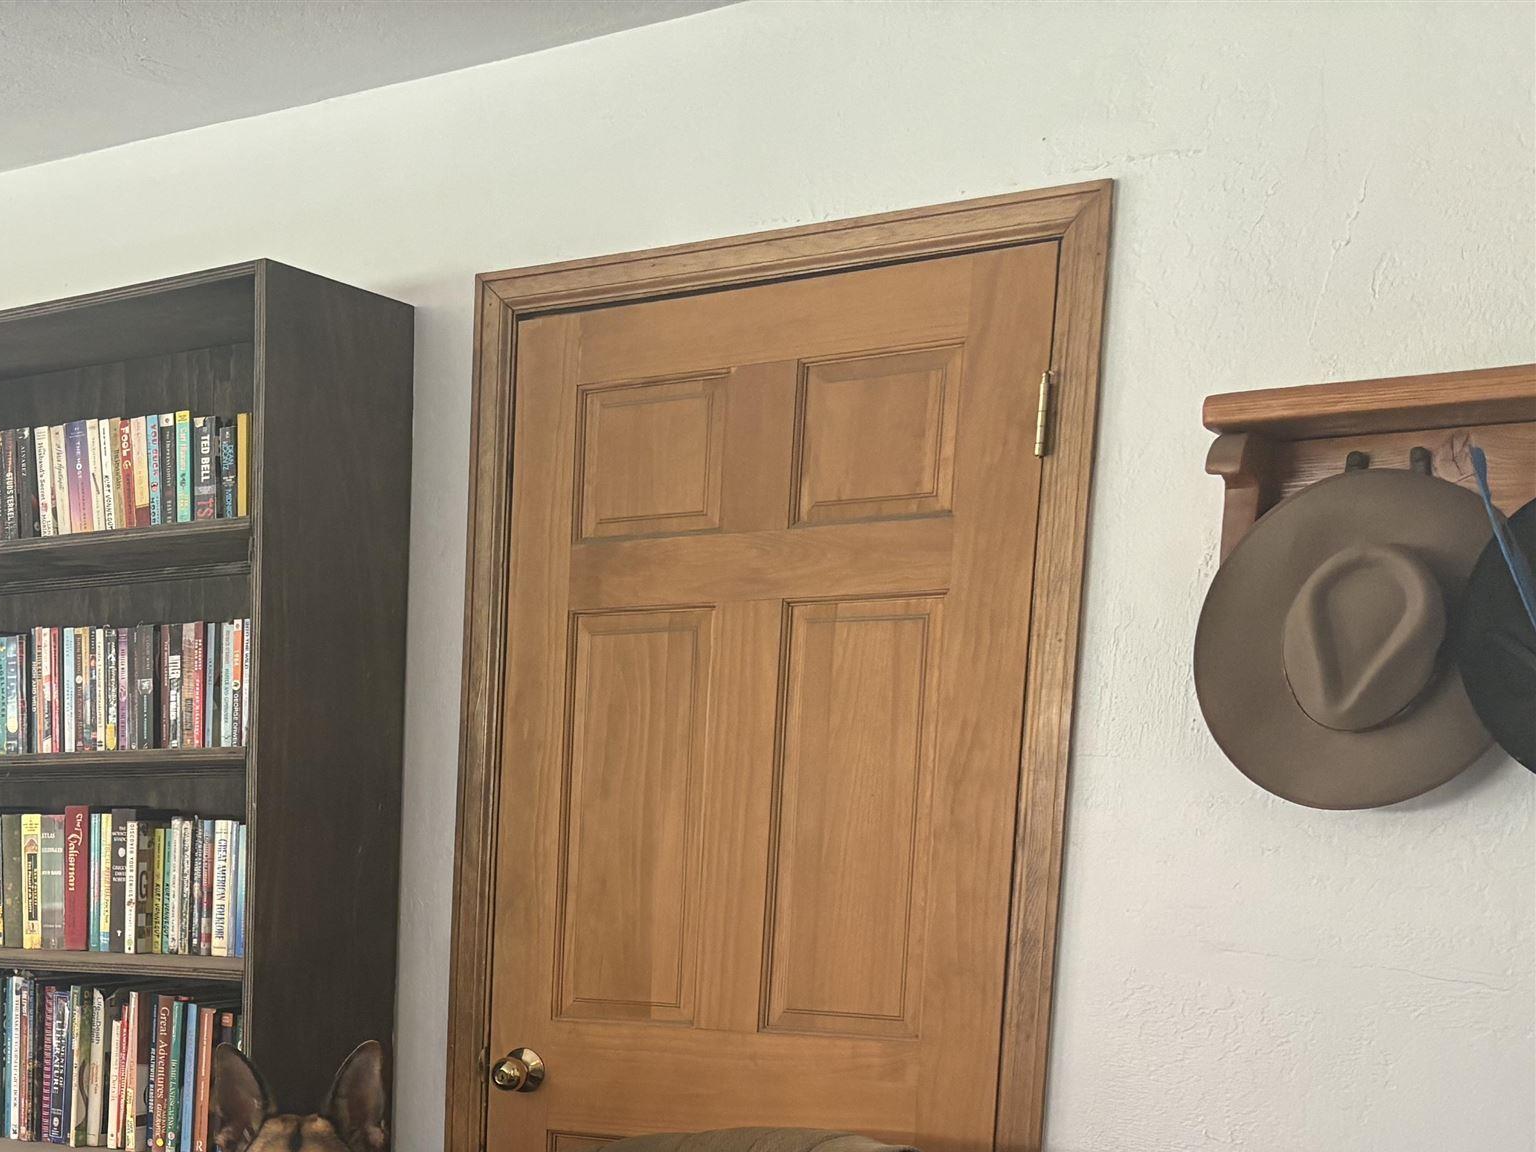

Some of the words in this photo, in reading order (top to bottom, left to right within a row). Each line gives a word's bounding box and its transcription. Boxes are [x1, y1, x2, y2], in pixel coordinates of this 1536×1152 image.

[200, 434, 210, 454] TED
[37, 442, 46, 479] Husband's
[201, 457, 210, 483] BELL
[6, 472, 14, 495] STUDS
[6, 495, 15, 522] TERKEL
[105, 494, 113, 529] VONNEGUT
[168, 655, 181, 680] HITLER
[67, 830, 82, 892] Talisman
[217, 839, 228, 863] GREAT
[216, 864, 227, 901] AMERICAN
[215, 904, 226, 940] FOLKLORE
[159, 1006, 170, 1036] Great
[156, 1040, 169, 1099] Adventures
